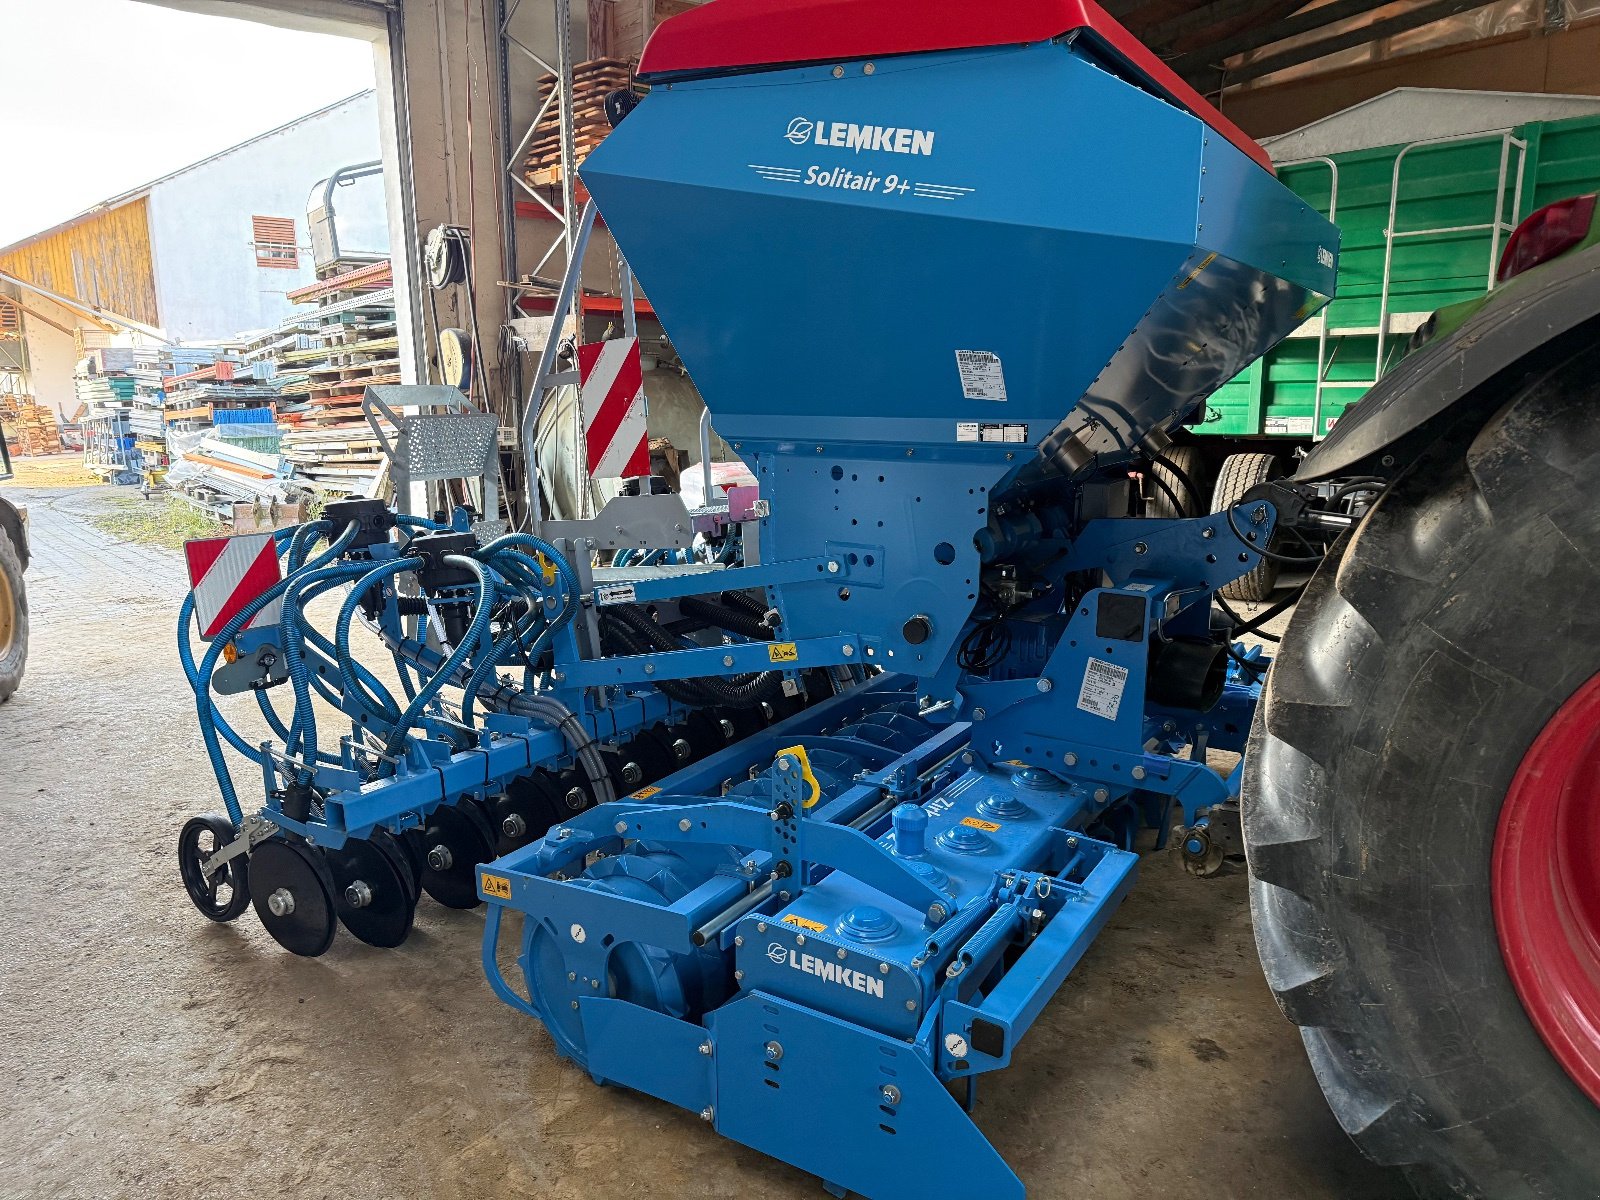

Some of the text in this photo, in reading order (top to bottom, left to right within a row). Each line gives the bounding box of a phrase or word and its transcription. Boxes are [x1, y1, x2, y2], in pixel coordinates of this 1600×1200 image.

[814, 120, 935, 156] LEMKEN
[803, 165, 911, 195] Solitair 9+
[789, 949, 884, 999] LEMKEN
